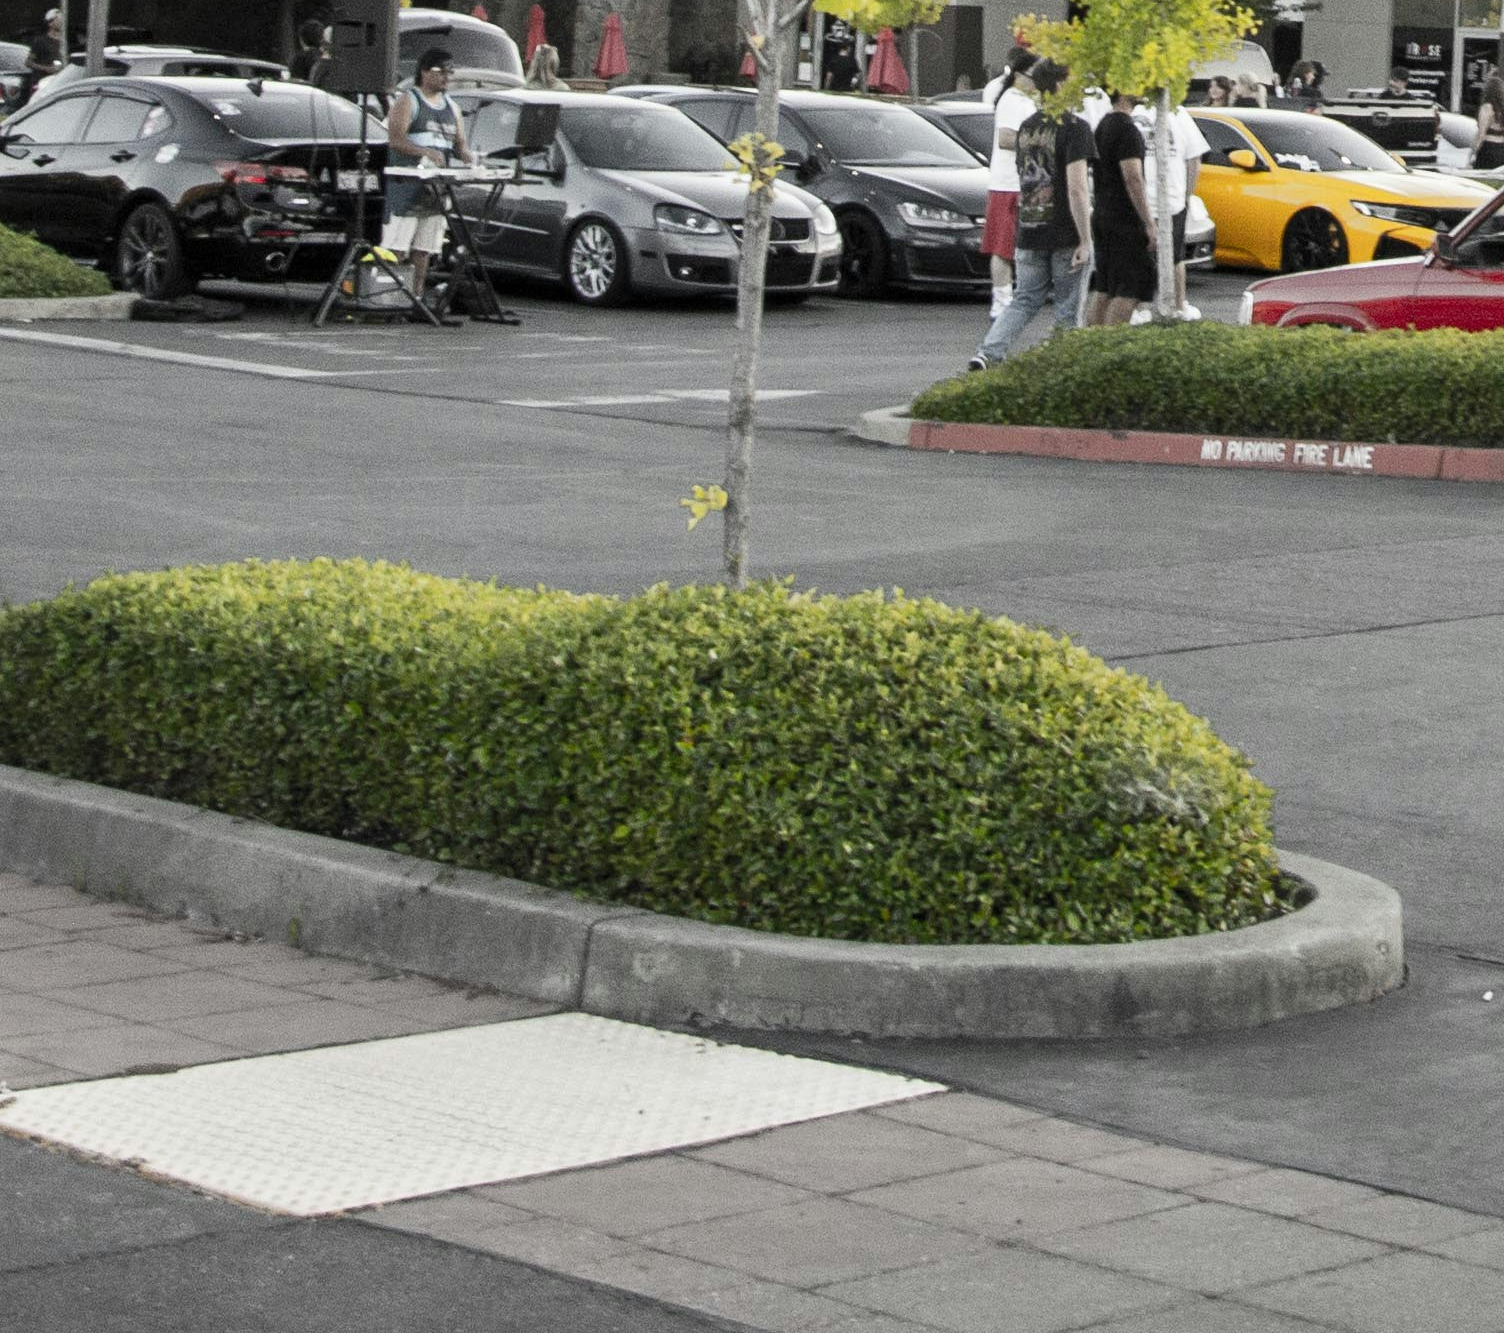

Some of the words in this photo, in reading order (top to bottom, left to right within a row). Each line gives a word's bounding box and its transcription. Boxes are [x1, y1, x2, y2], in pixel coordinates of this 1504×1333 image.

[1200, 439, 1223, 460] NO
[1225, 441, 1286, 463] PARKING
[1293, 443, 1329, 466] FIRE
[1332, 446, 1374, 469] LANE
